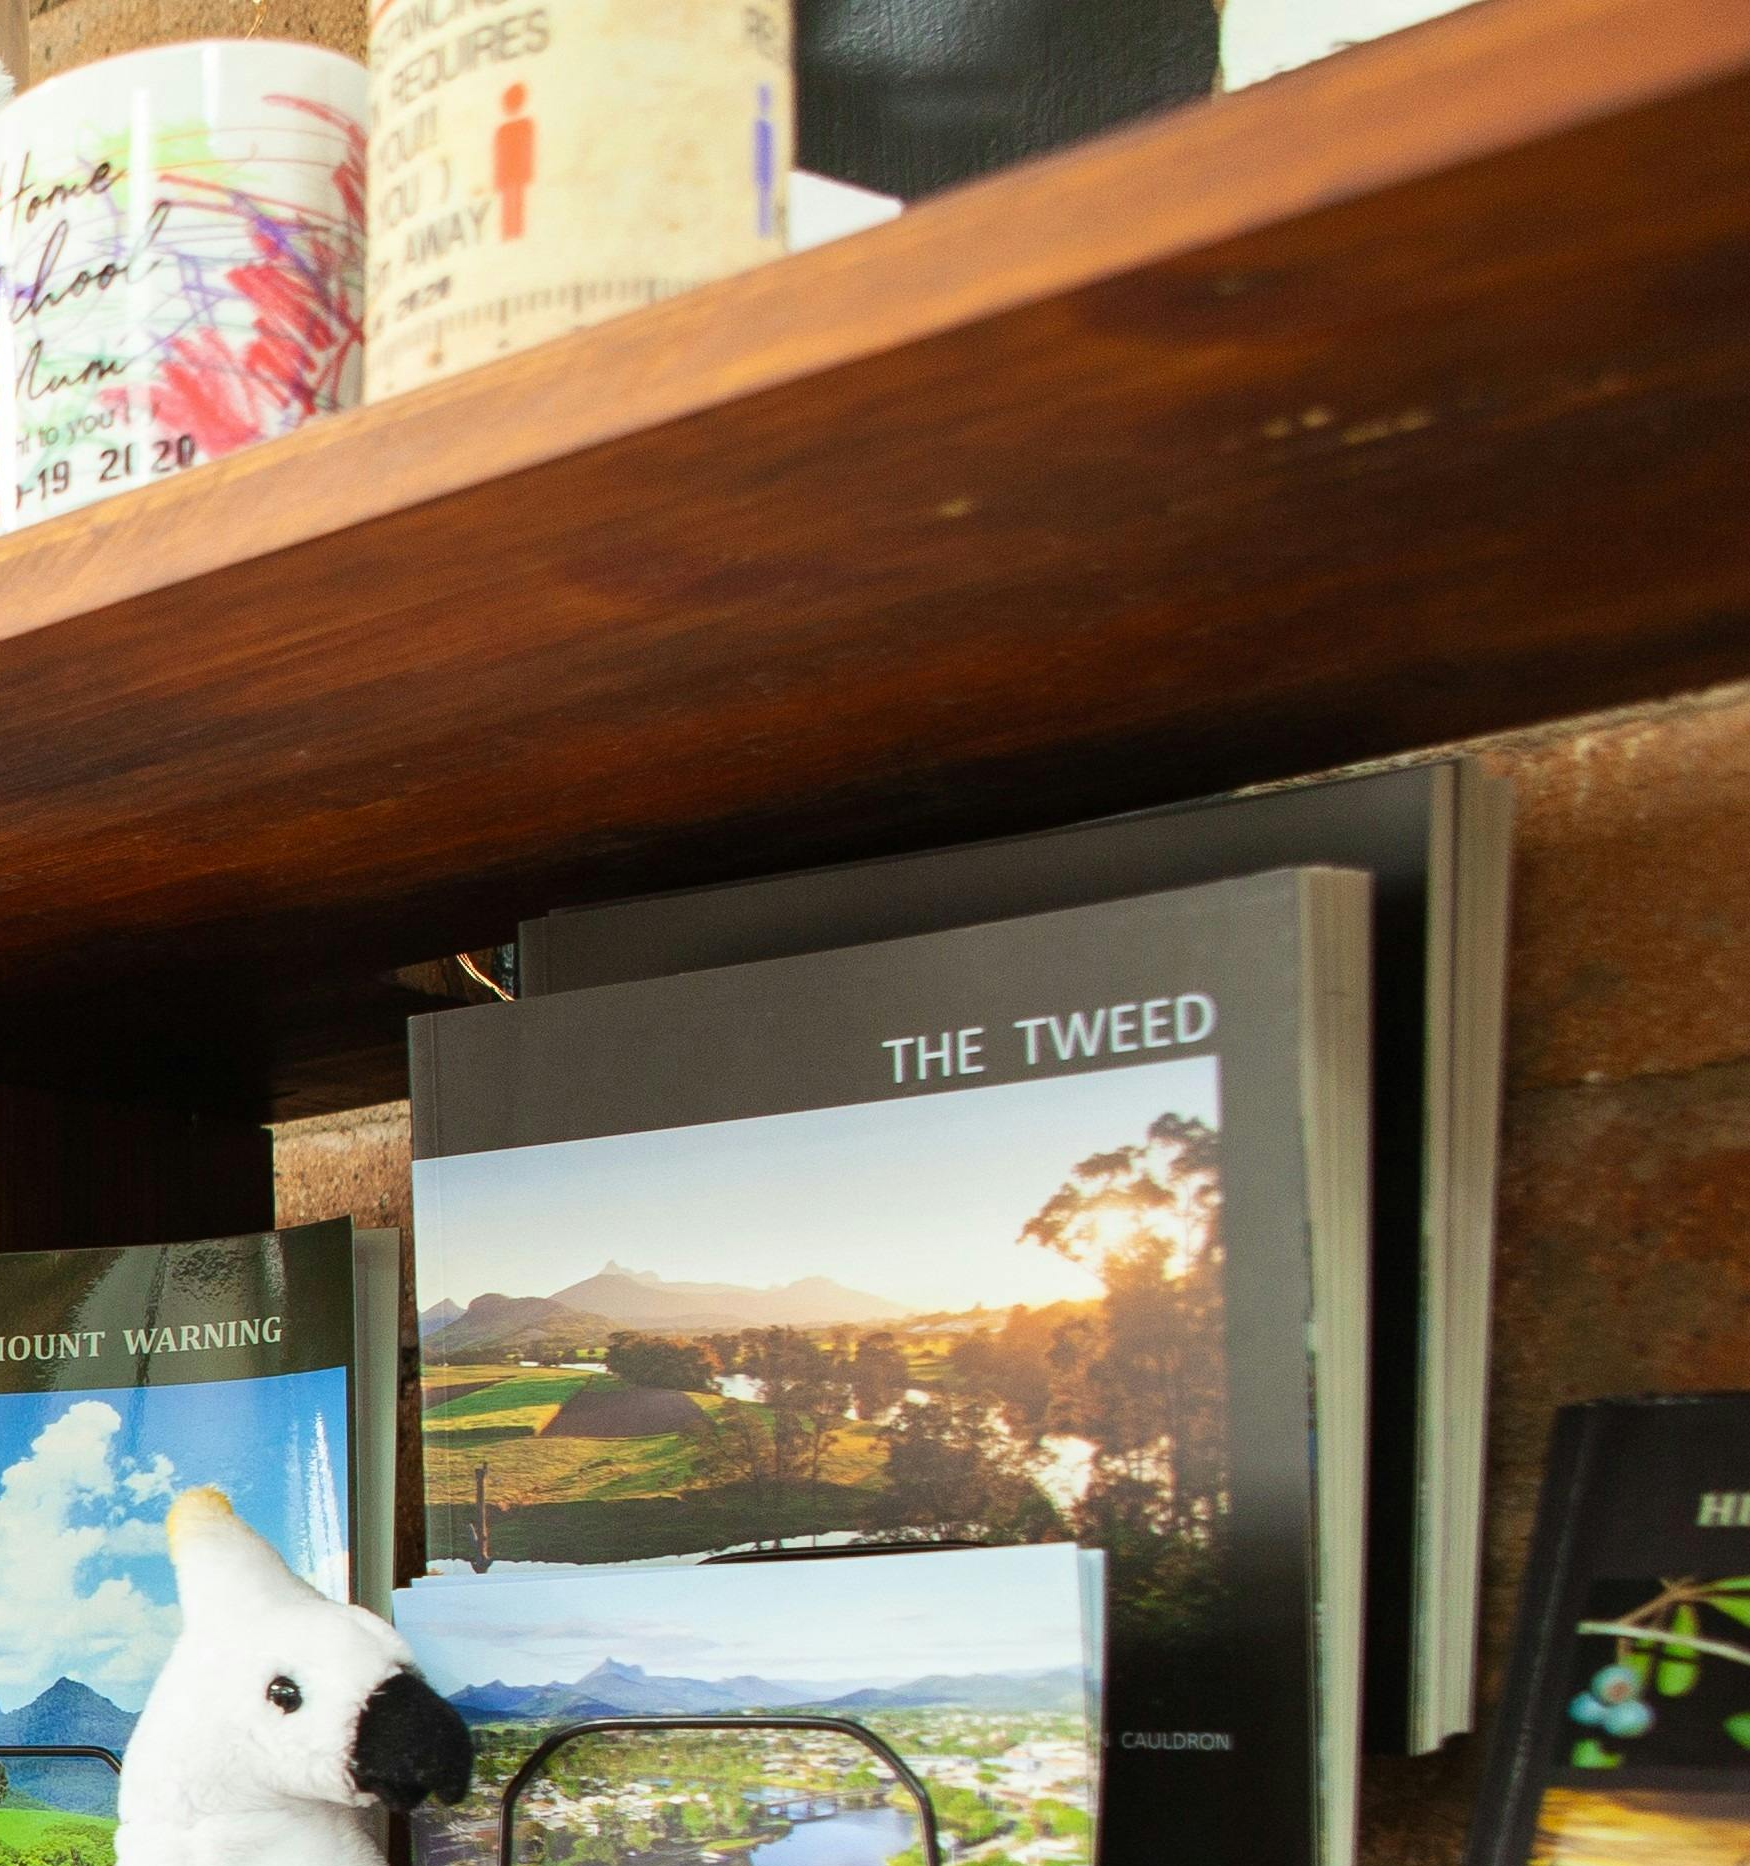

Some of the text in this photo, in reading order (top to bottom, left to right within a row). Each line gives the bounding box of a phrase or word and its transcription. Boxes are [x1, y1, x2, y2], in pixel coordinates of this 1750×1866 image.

[405, 200, 492, 266] AWAY
[881, 993, 1218, 1084] THE TWEED
[122, 1316, 282, 1356] WARNING
[1121, 1732, 1231, 1750] CAULDRON
